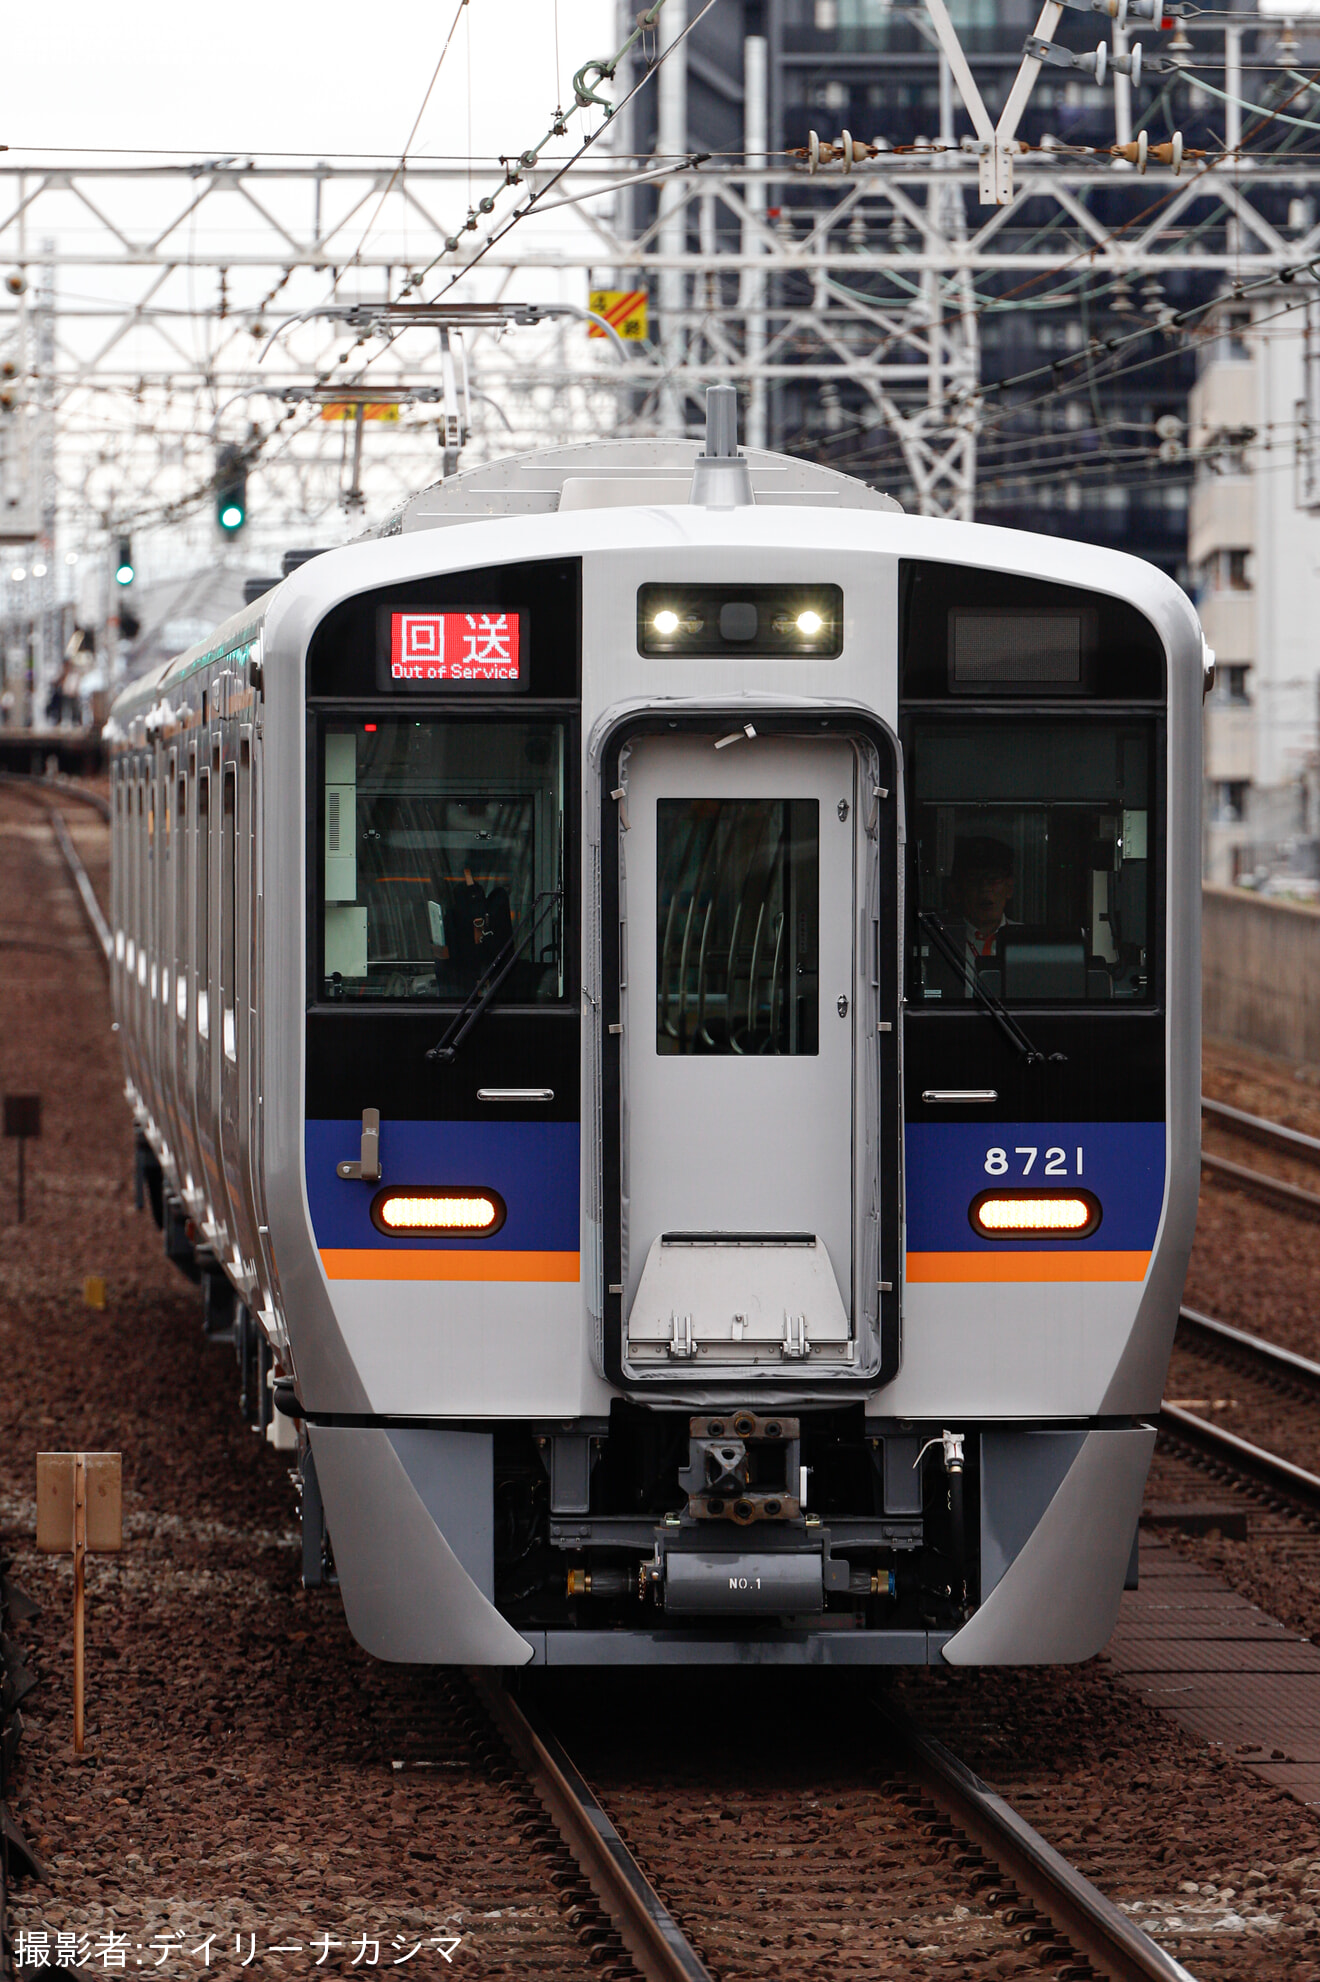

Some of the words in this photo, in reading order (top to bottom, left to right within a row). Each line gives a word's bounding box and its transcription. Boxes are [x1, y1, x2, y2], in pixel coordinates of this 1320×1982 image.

[401, 614, 512, 663] 回送
[391, 663, 423, 679] Out
[427, 665, 447, 679] of
[451, 663, 518, 679] Service
[984, 1147, 1083, 1175] 8721
[729, 1578, 761, 1590] NO.1
